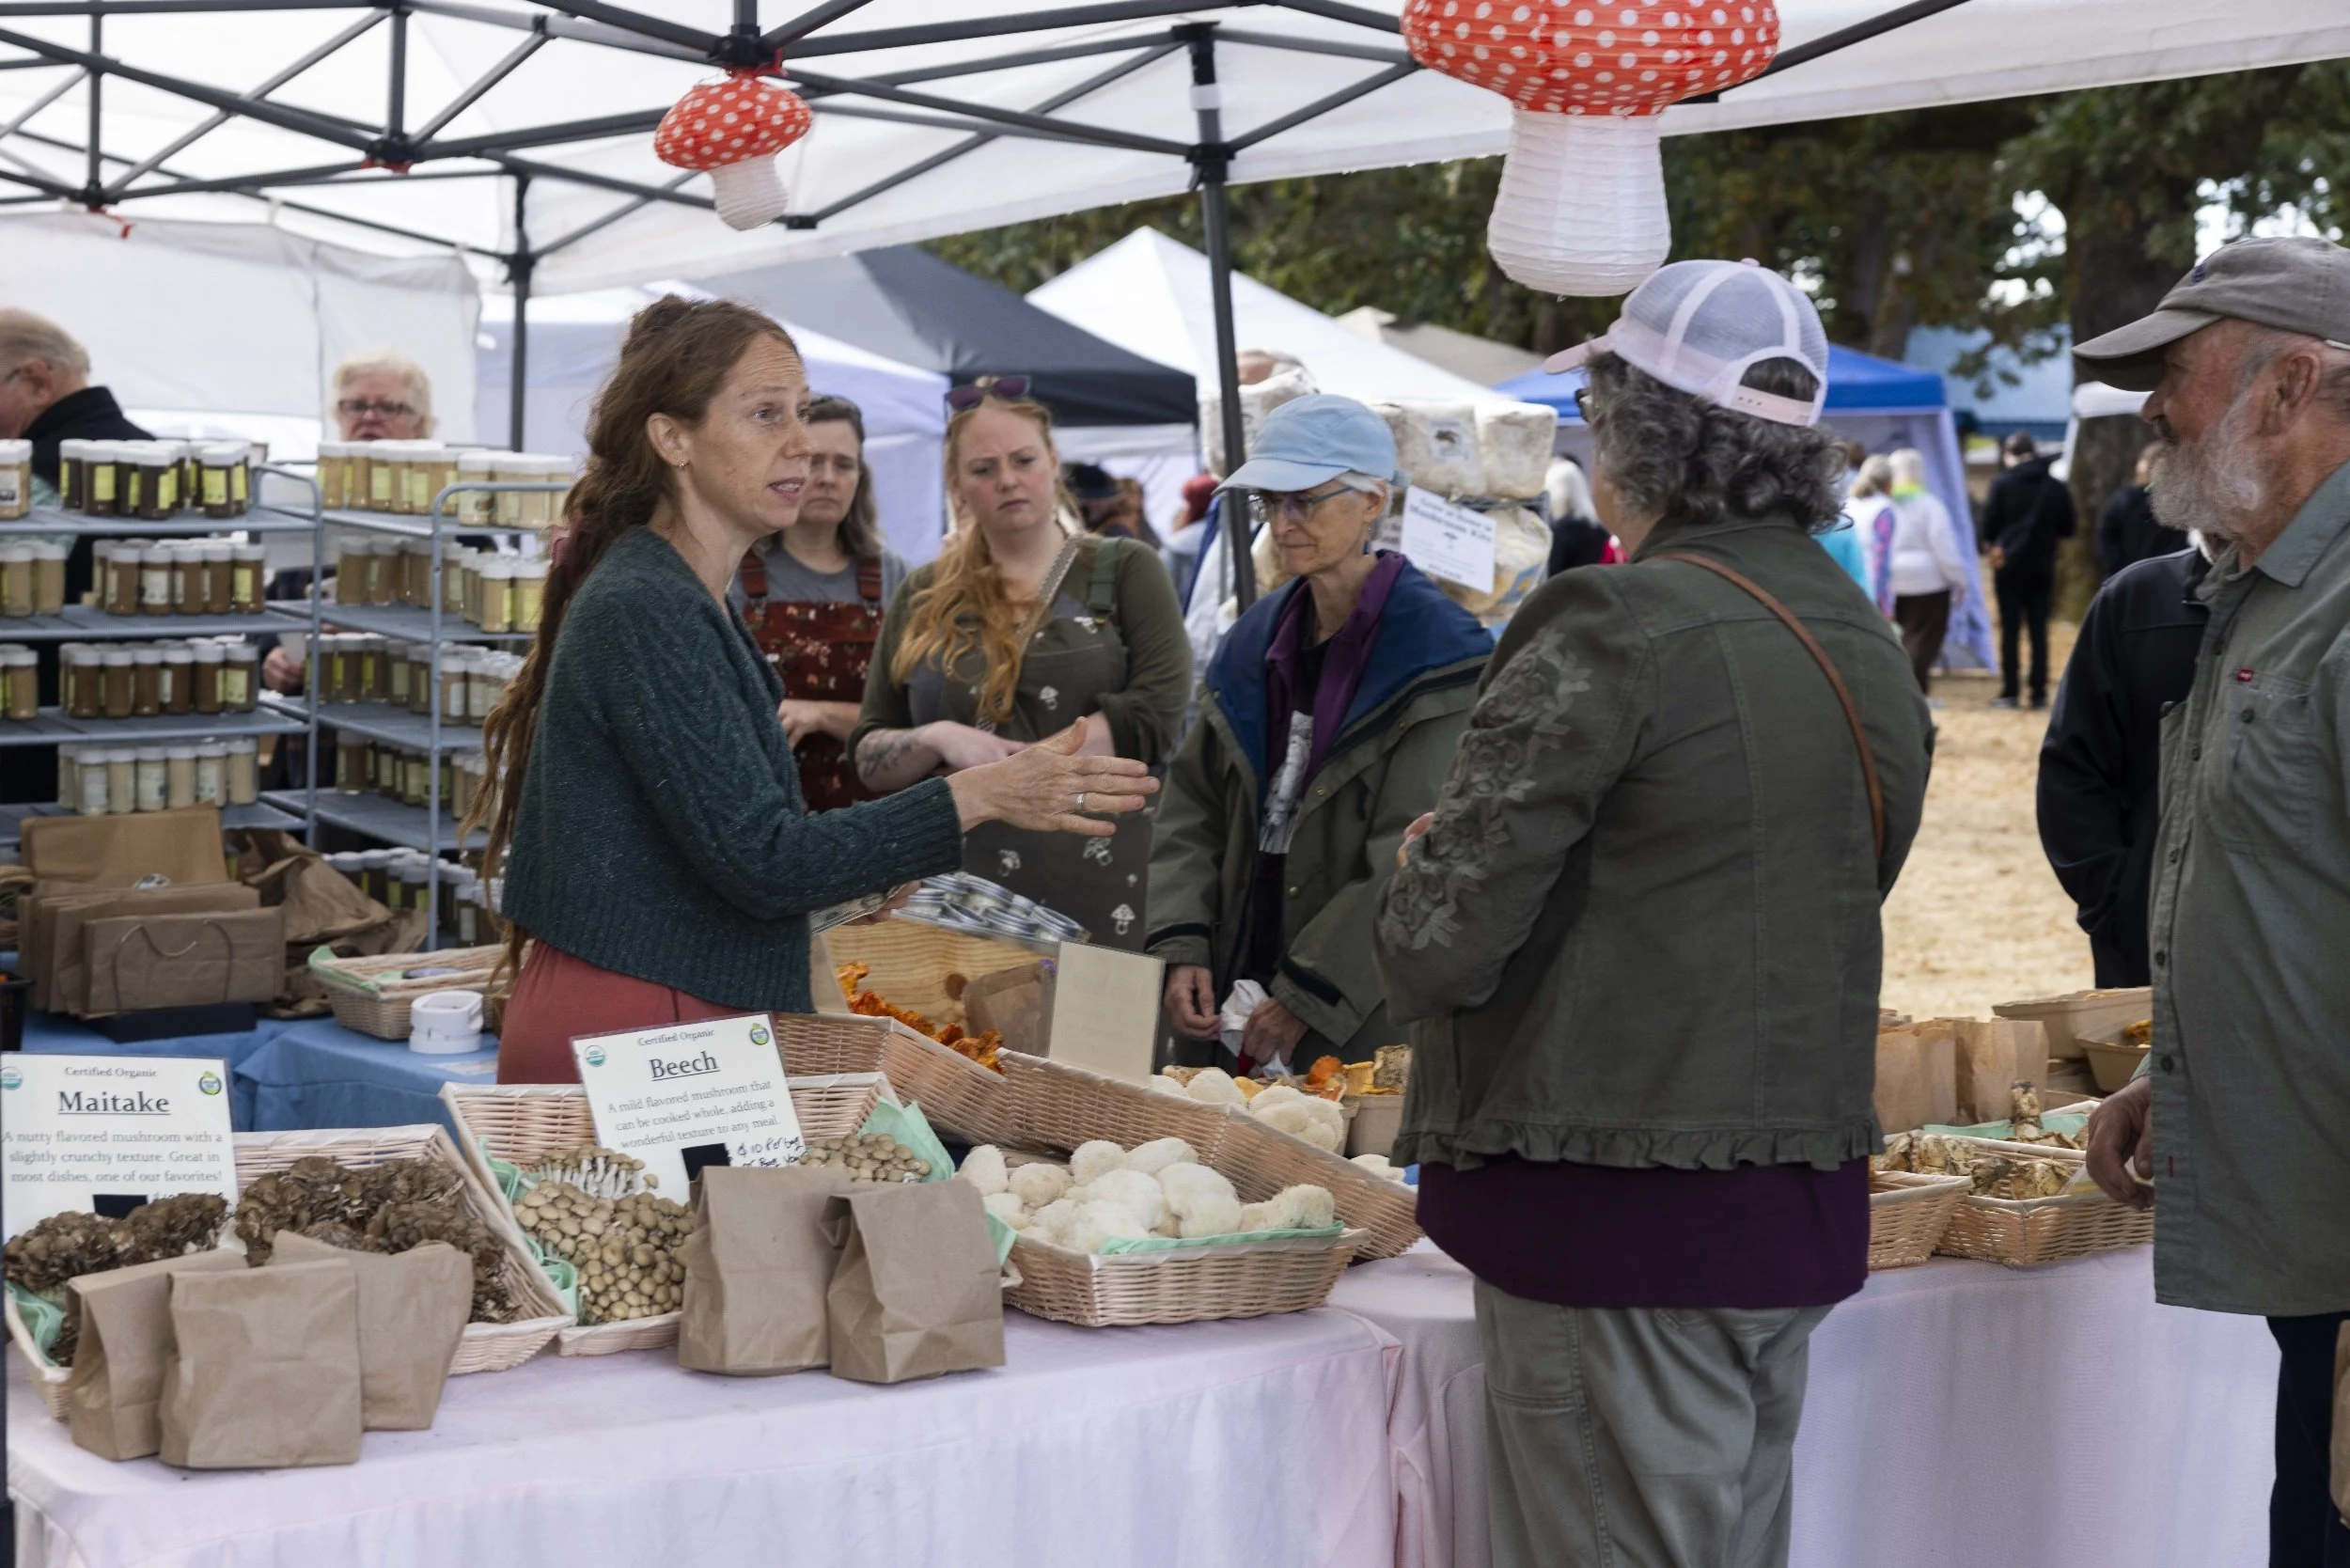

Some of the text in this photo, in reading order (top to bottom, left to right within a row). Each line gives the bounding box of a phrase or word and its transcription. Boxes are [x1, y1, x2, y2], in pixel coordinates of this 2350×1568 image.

[638, 1027, 714, 1046] Certified Organic
[64, 1067, 158, 1079] Certified Organic
[649, 1051, 720, 1080] Beech
[58, 1090, 172, 1116] Maitake
[607, 1080, 772, 1114] A mild flavored mushroom that
[616, 1099, 775, 1131] can be cooked whole, adding a
[3, 1131, 223, 1145] A nutty flavored mushroom with a
[620, 1116, 781, 1150] wonderful texture to any meal.
[9, 1150, 220, 1166] slightly crunchy texture. Great in
[10, 1170, 223, 1184] most dishes, one of our favorites!
